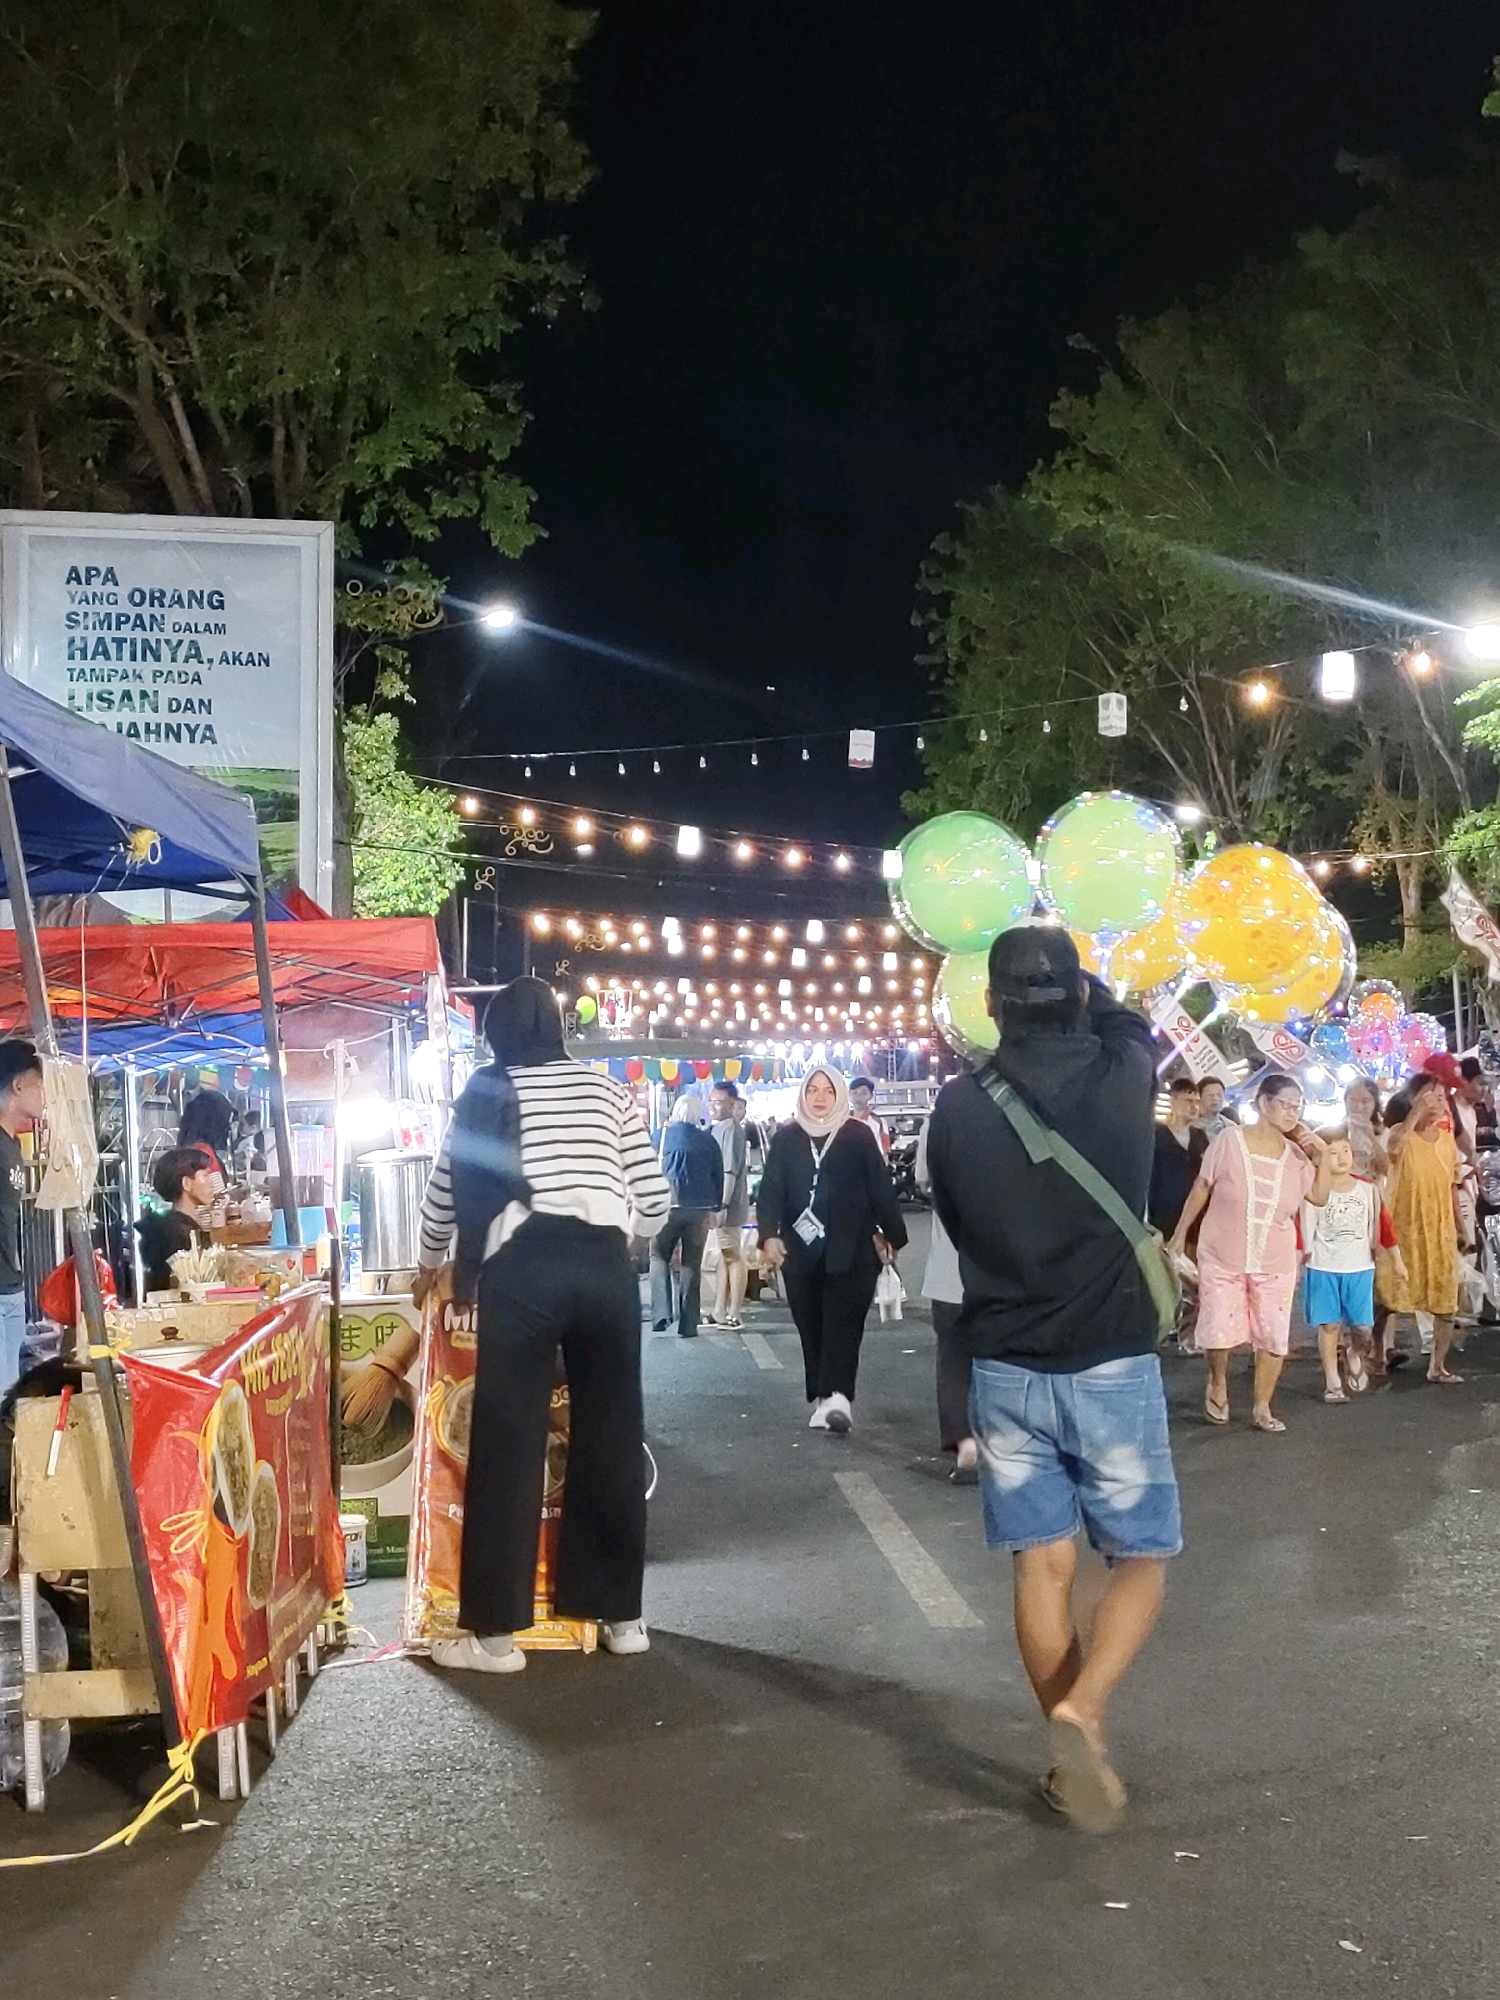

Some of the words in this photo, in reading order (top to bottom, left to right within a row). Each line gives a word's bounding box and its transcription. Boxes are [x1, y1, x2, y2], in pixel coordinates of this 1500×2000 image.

[65, 565, 119, 587] APA
[66, 590, 119, 606] YANG
[127, 586, 225, 611] ORANG
[65, 611, 166, 633] SIMPAN
[172, 621, 227, 636] DALAM
[66, 635, 214, 670] HATINYA,
[218, 651, 271, 668] AKAN
[66, 667, 145, 684] TAMPAK
[151, 669, 203, 686] PADA
[67, 688, 160, 714] LISAN
[167, 696, 213, 715] DAN
